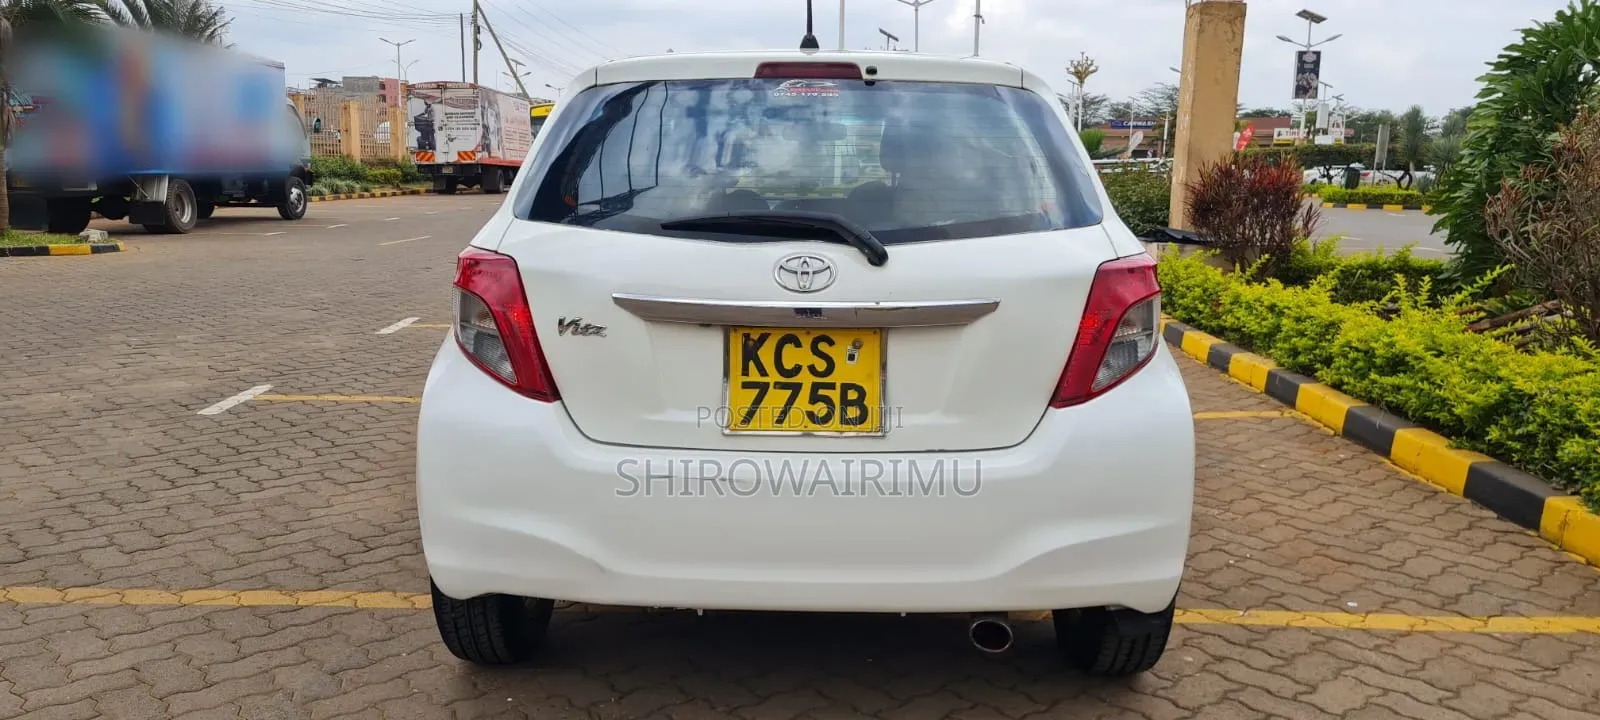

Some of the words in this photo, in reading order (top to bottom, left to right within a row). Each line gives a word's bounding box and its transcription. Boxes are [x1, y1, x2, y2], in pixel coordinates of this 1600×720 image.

[558, 316, 607, 337] Vitz
[741, 332, 836, 378] KCS
[740, 382, 869, 426] 775B
